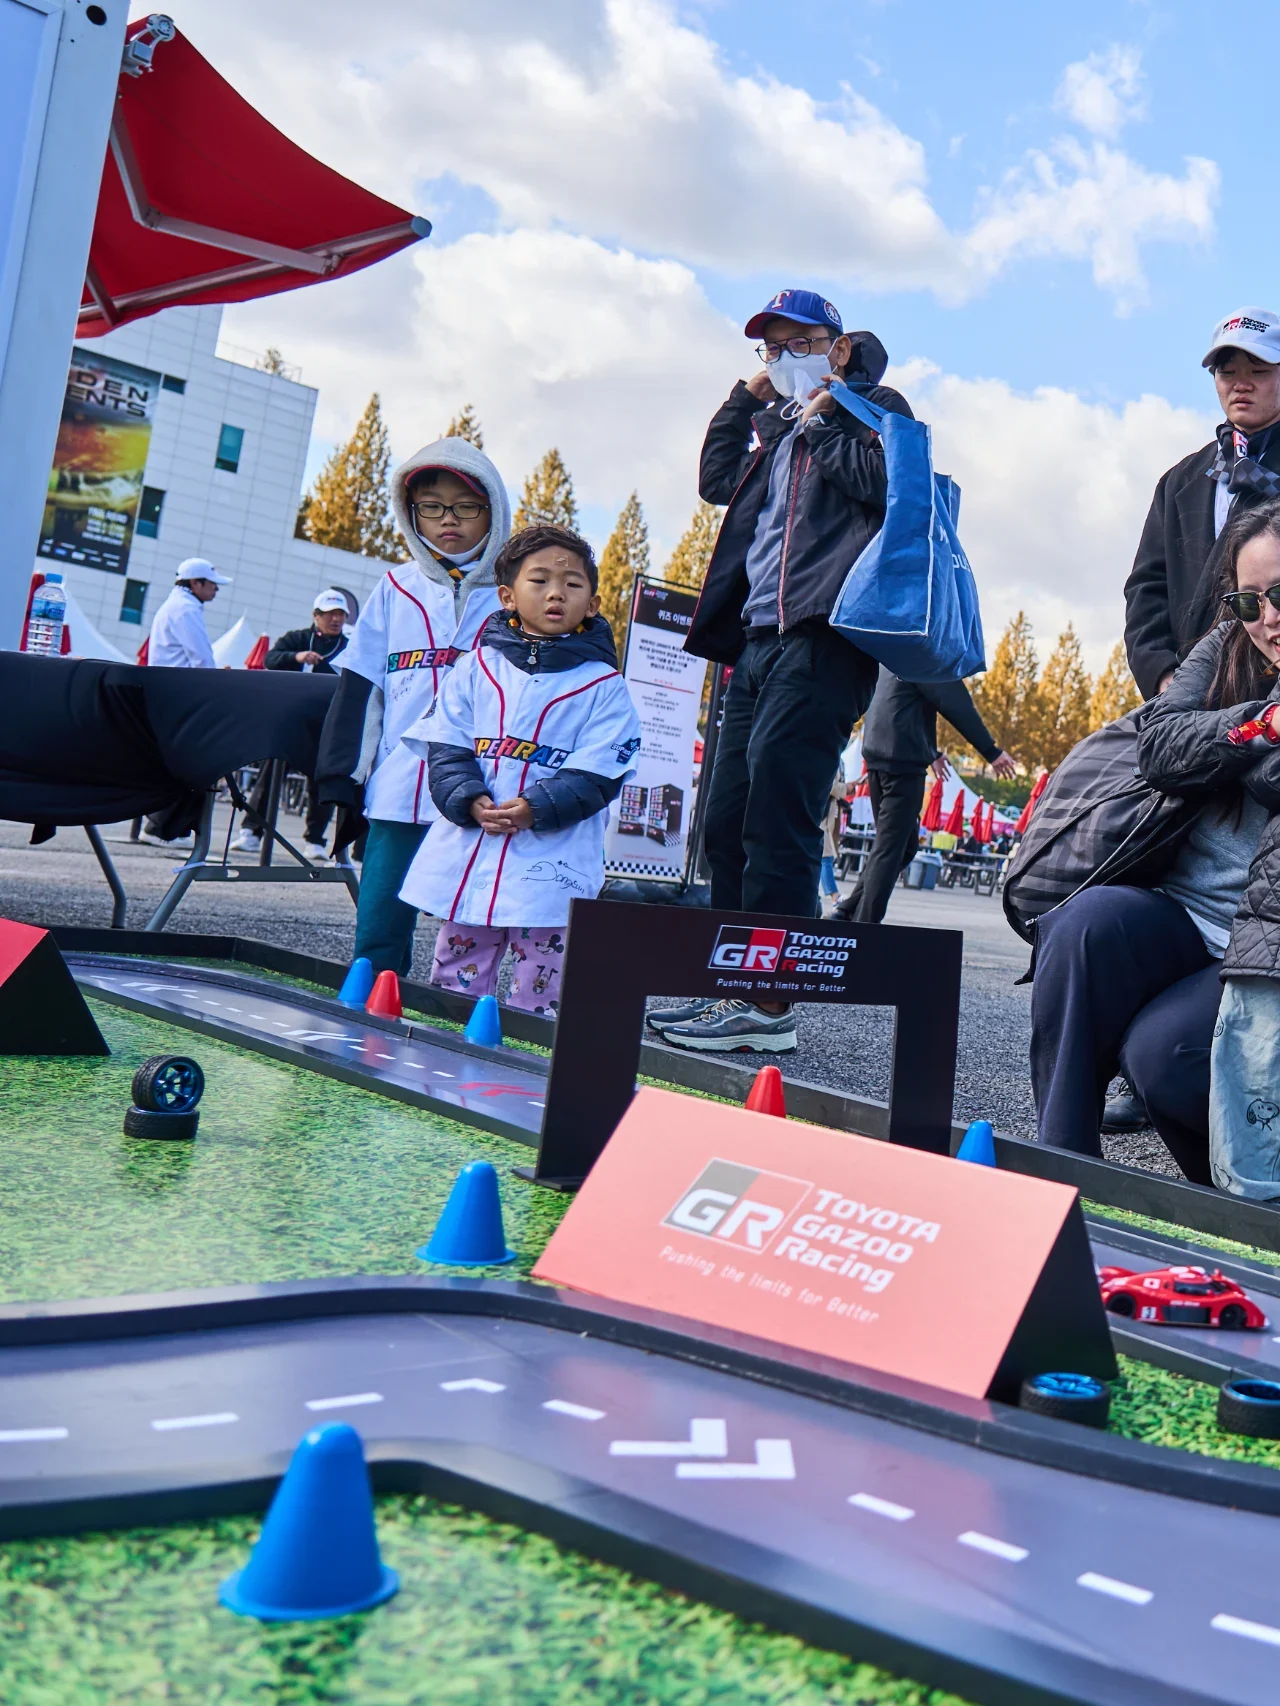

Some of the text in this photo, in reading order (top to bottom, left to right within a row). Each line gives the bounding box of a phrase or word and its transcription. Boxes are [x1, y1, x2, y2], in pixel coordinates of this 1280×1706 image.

[475, 737, 568, 768] PERRAC
[713, 932, 858, 969] GR TOYOTA
[780, 959, 845, 978] Racing
[784, 946, 849, 962] GAZOO
[716, 978, 847, 993] Pushing the limits for Better
[671, 1188, 942, 1249] GR TOYOTA
[791, 1213, 915, 1264] GAZOO
[774, 1235, 895, 1294] Racing
[659, 1245, 880, 1324] Pushing the limits for Better
